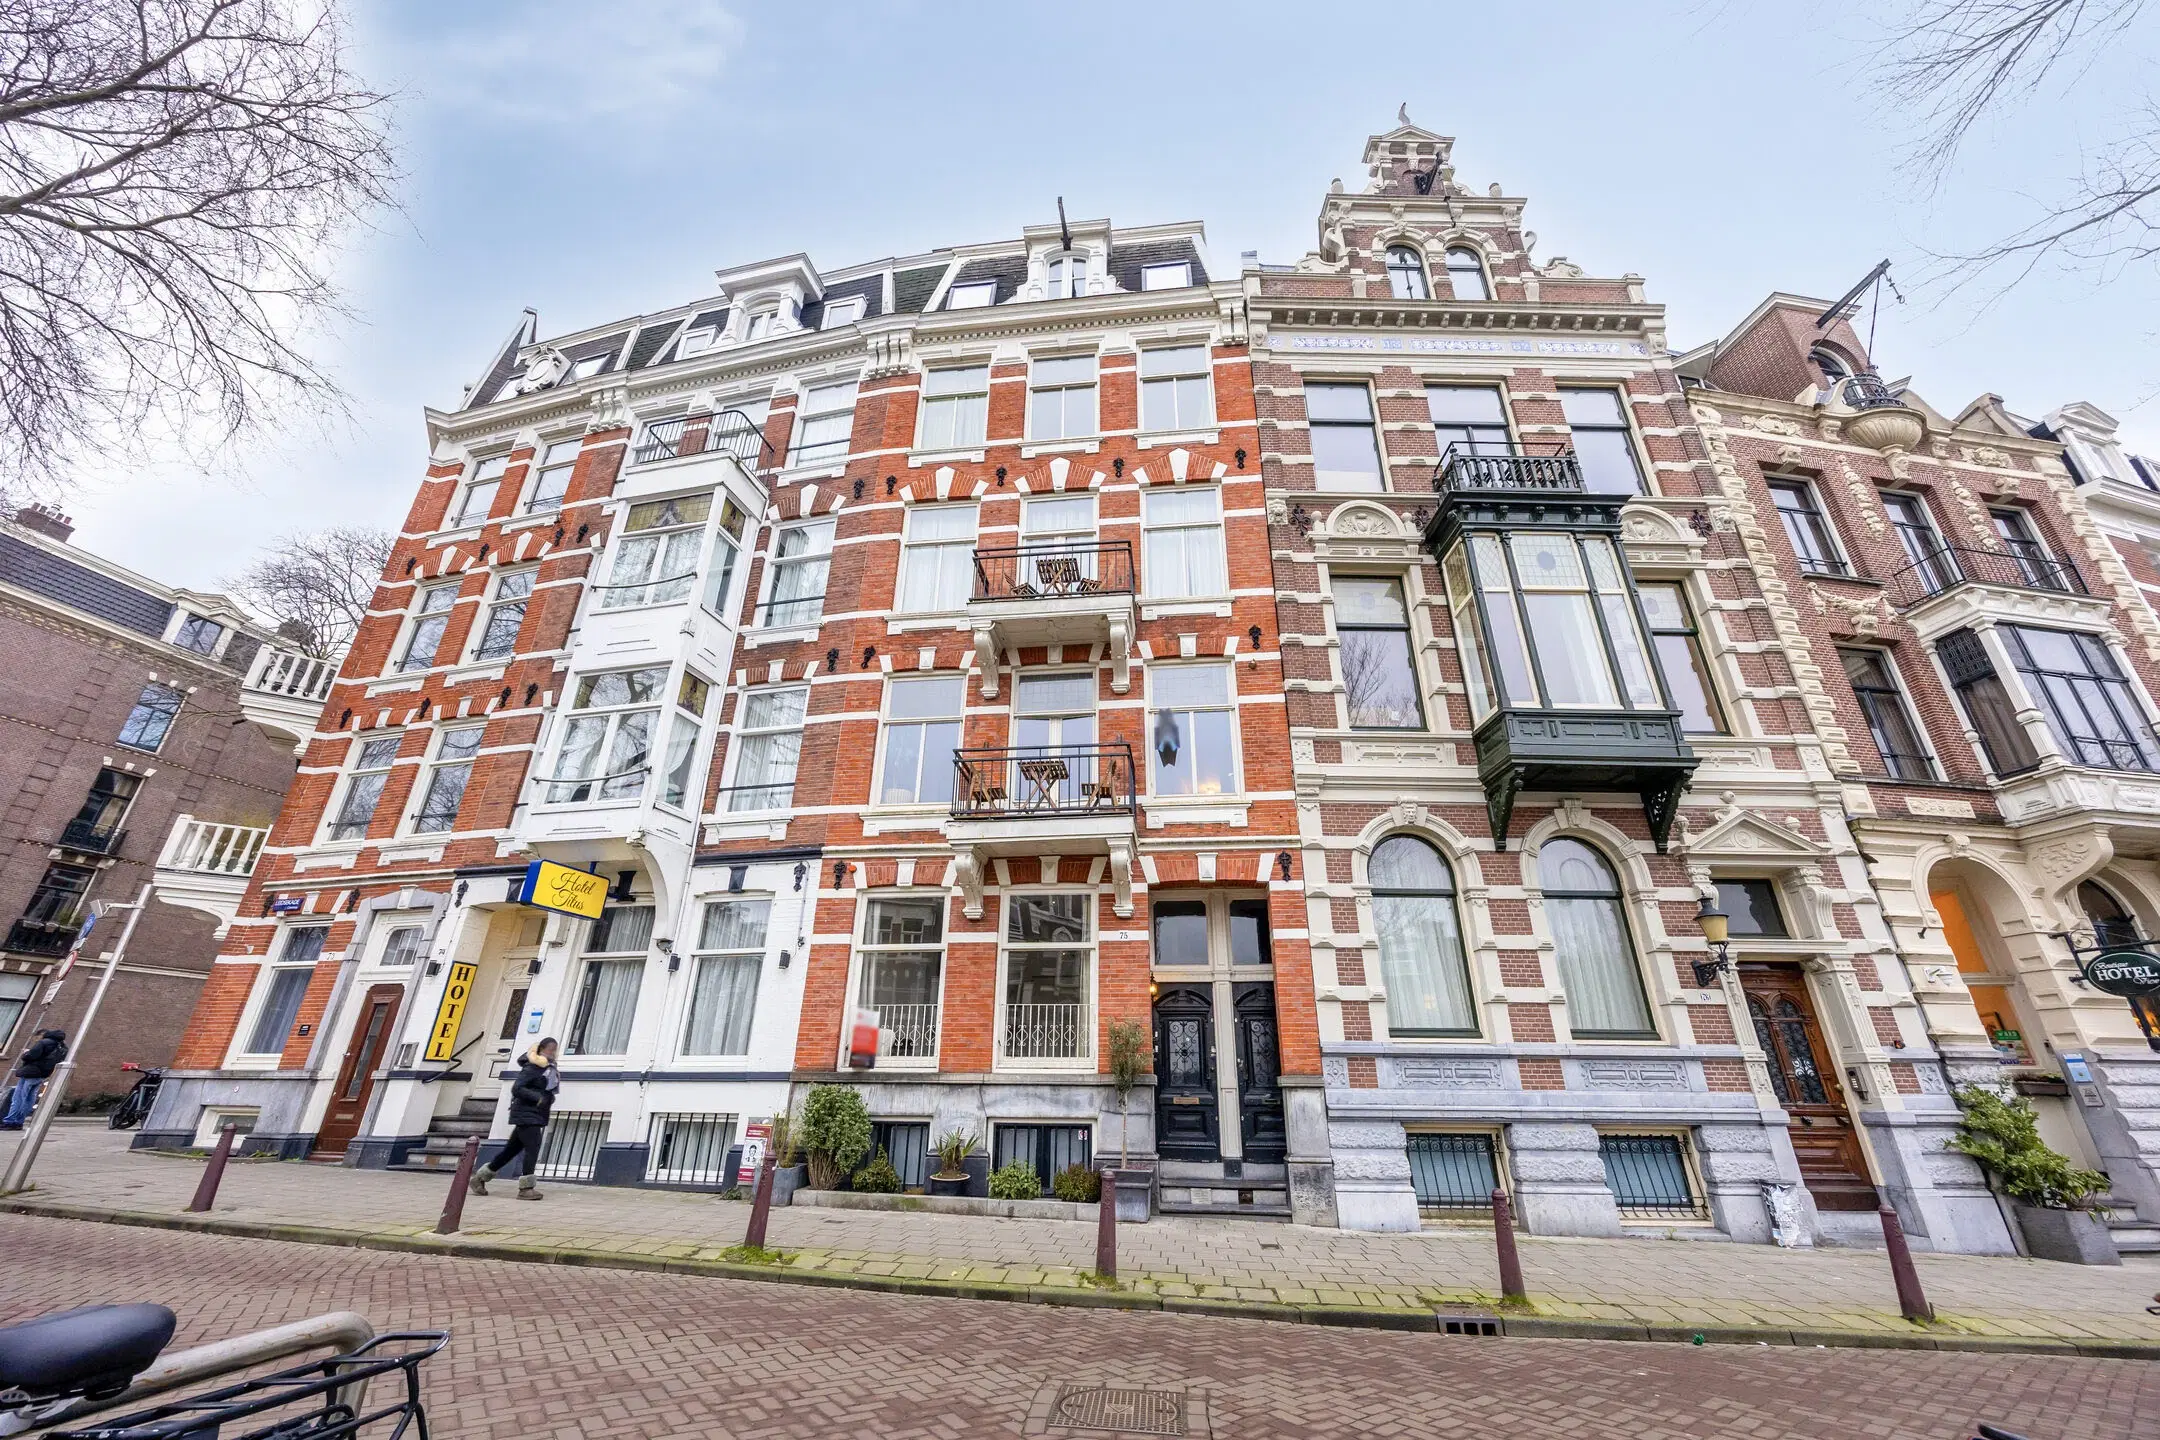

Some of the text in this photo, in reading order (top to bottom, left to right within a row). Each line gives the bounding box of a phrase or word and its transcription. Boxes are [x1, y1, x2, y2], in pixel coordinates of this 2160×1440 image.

[551, 872, 597, 895] Hotel
[552, 889, 584, 911] Titus
[1119, 931, 1129, 940] 75
[2096, 965, 2159, 981] HOTEL
[433, 966, 472, 1058] HOTEL
